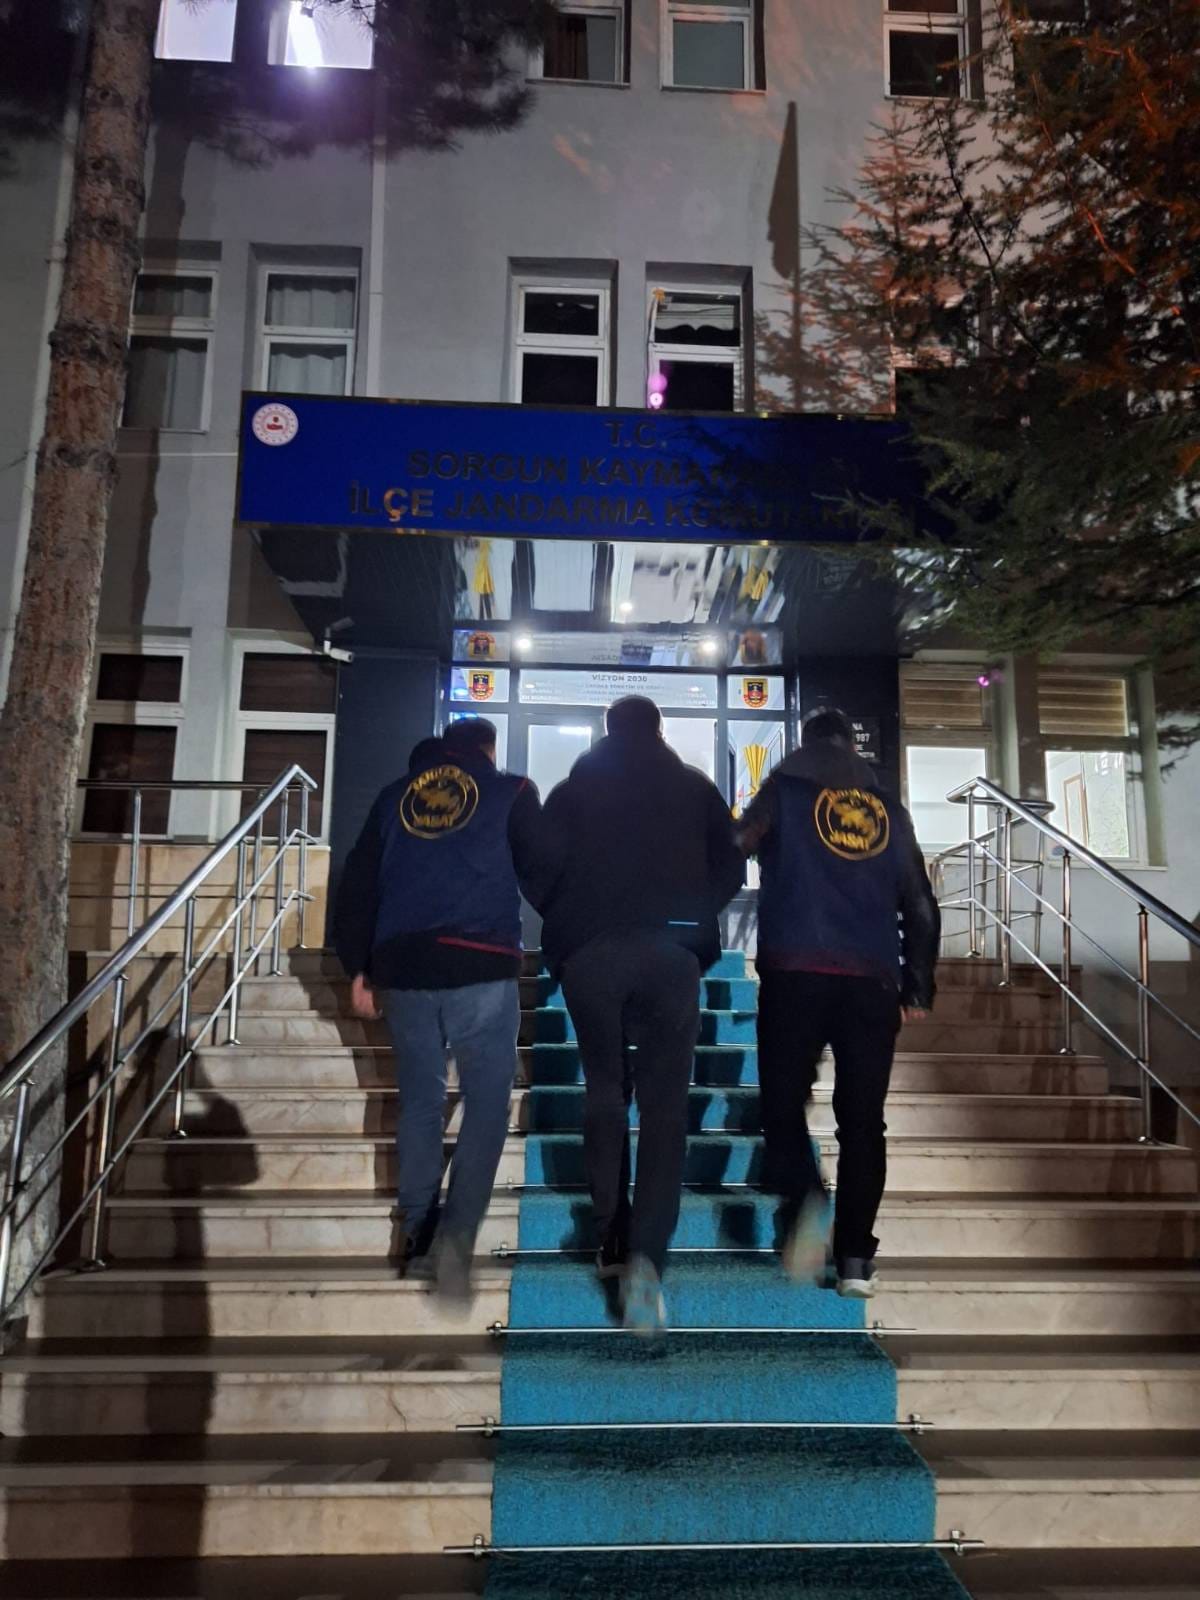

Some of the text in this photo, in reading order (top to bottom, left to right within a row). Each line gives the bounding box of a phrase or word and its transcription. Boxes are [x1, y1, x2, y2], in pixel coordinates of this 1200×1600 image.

[604, 420, 668, 449] T.C.
[406, 450, 569, 483] SORGUN
[350, 480, 435, 522] İLÇE
[445, 493, 656, 527] JANDARMA
[591, 673, 648, 682] VİZYON 2030
